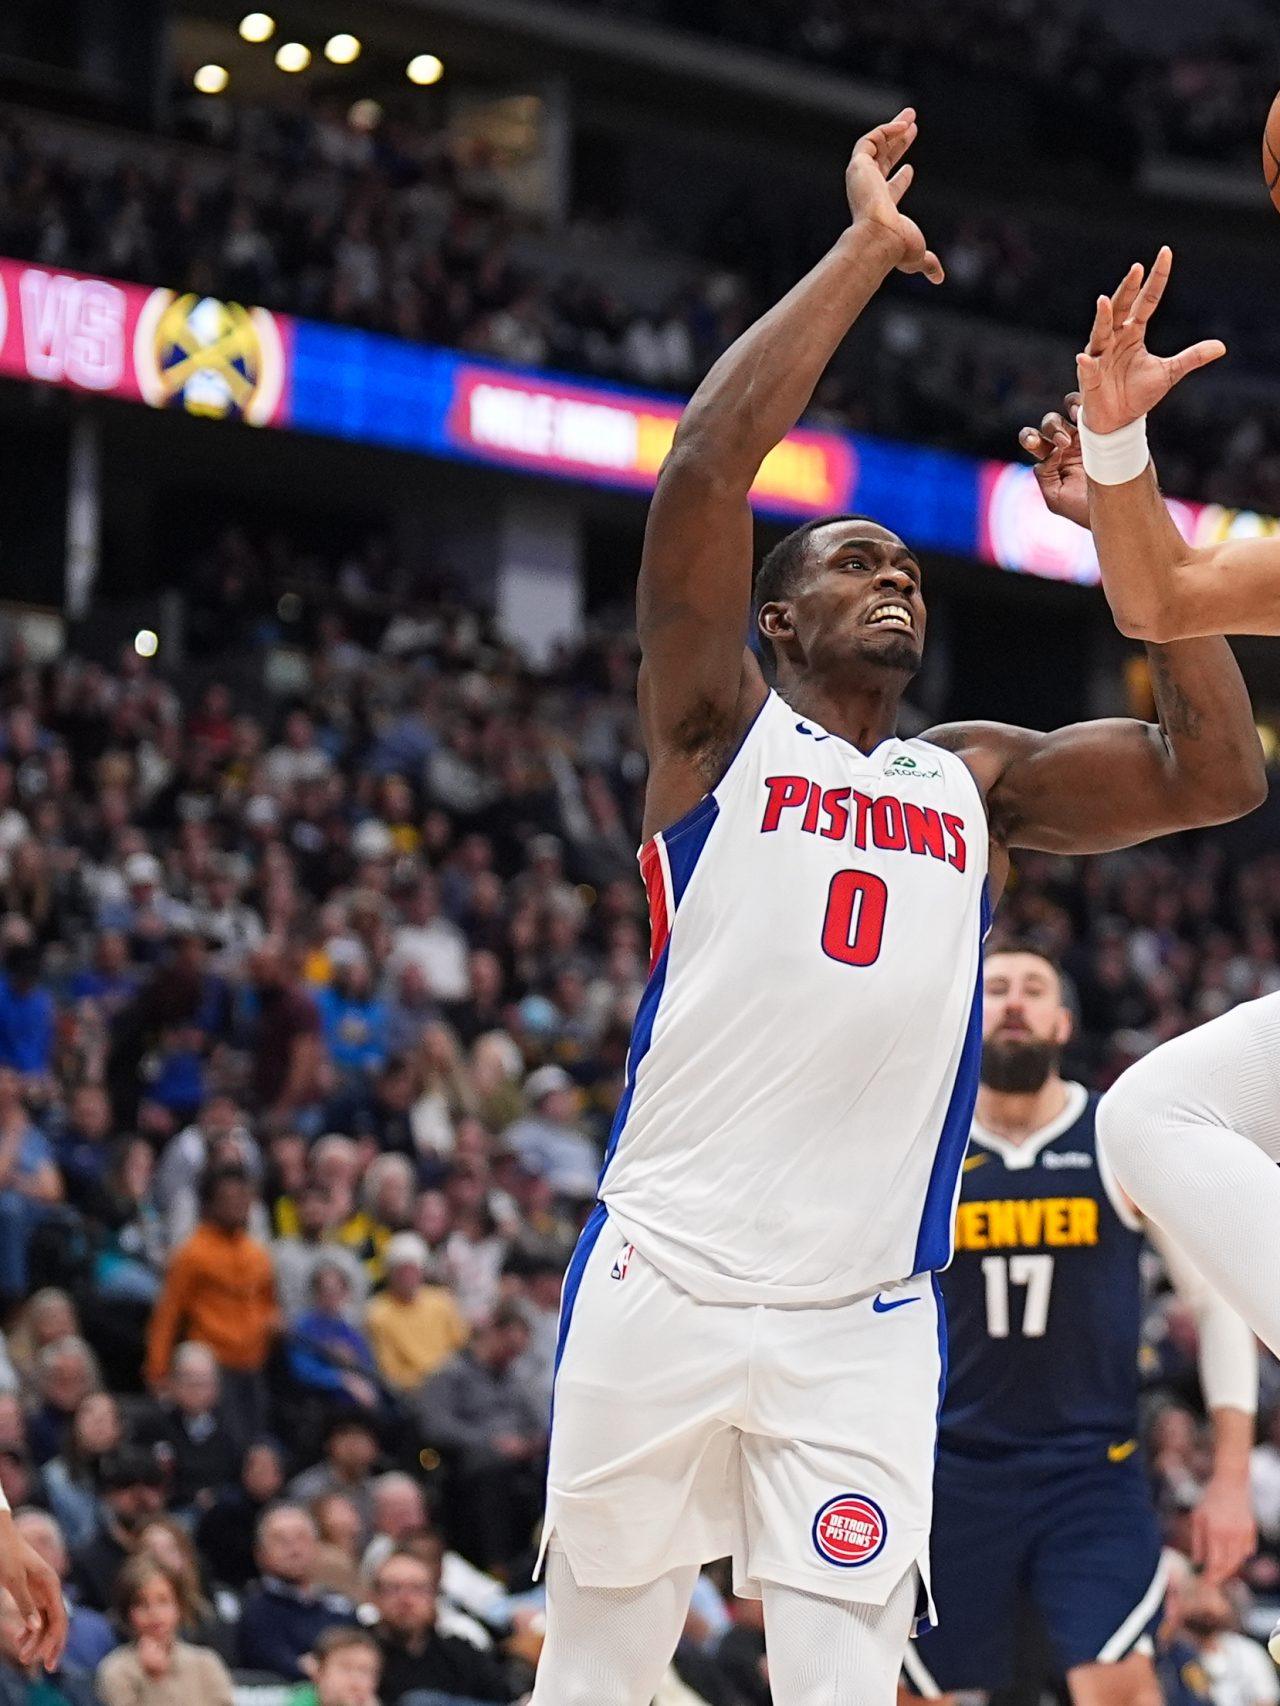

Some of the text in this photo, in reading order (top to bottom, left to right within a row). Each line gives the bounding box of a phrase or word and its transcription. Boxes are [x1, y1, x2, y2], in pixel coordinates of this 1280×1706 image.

[19, 269, 127, 390] VS
[761, 775, 966, 873] PISTONS
[821, 869, 888, 967] 0
[981, 1254, 1054, 1338] 17
[825, 1525, 872, 1548] PISTONS
[829, 1513, 874, 1536] DETROIT
